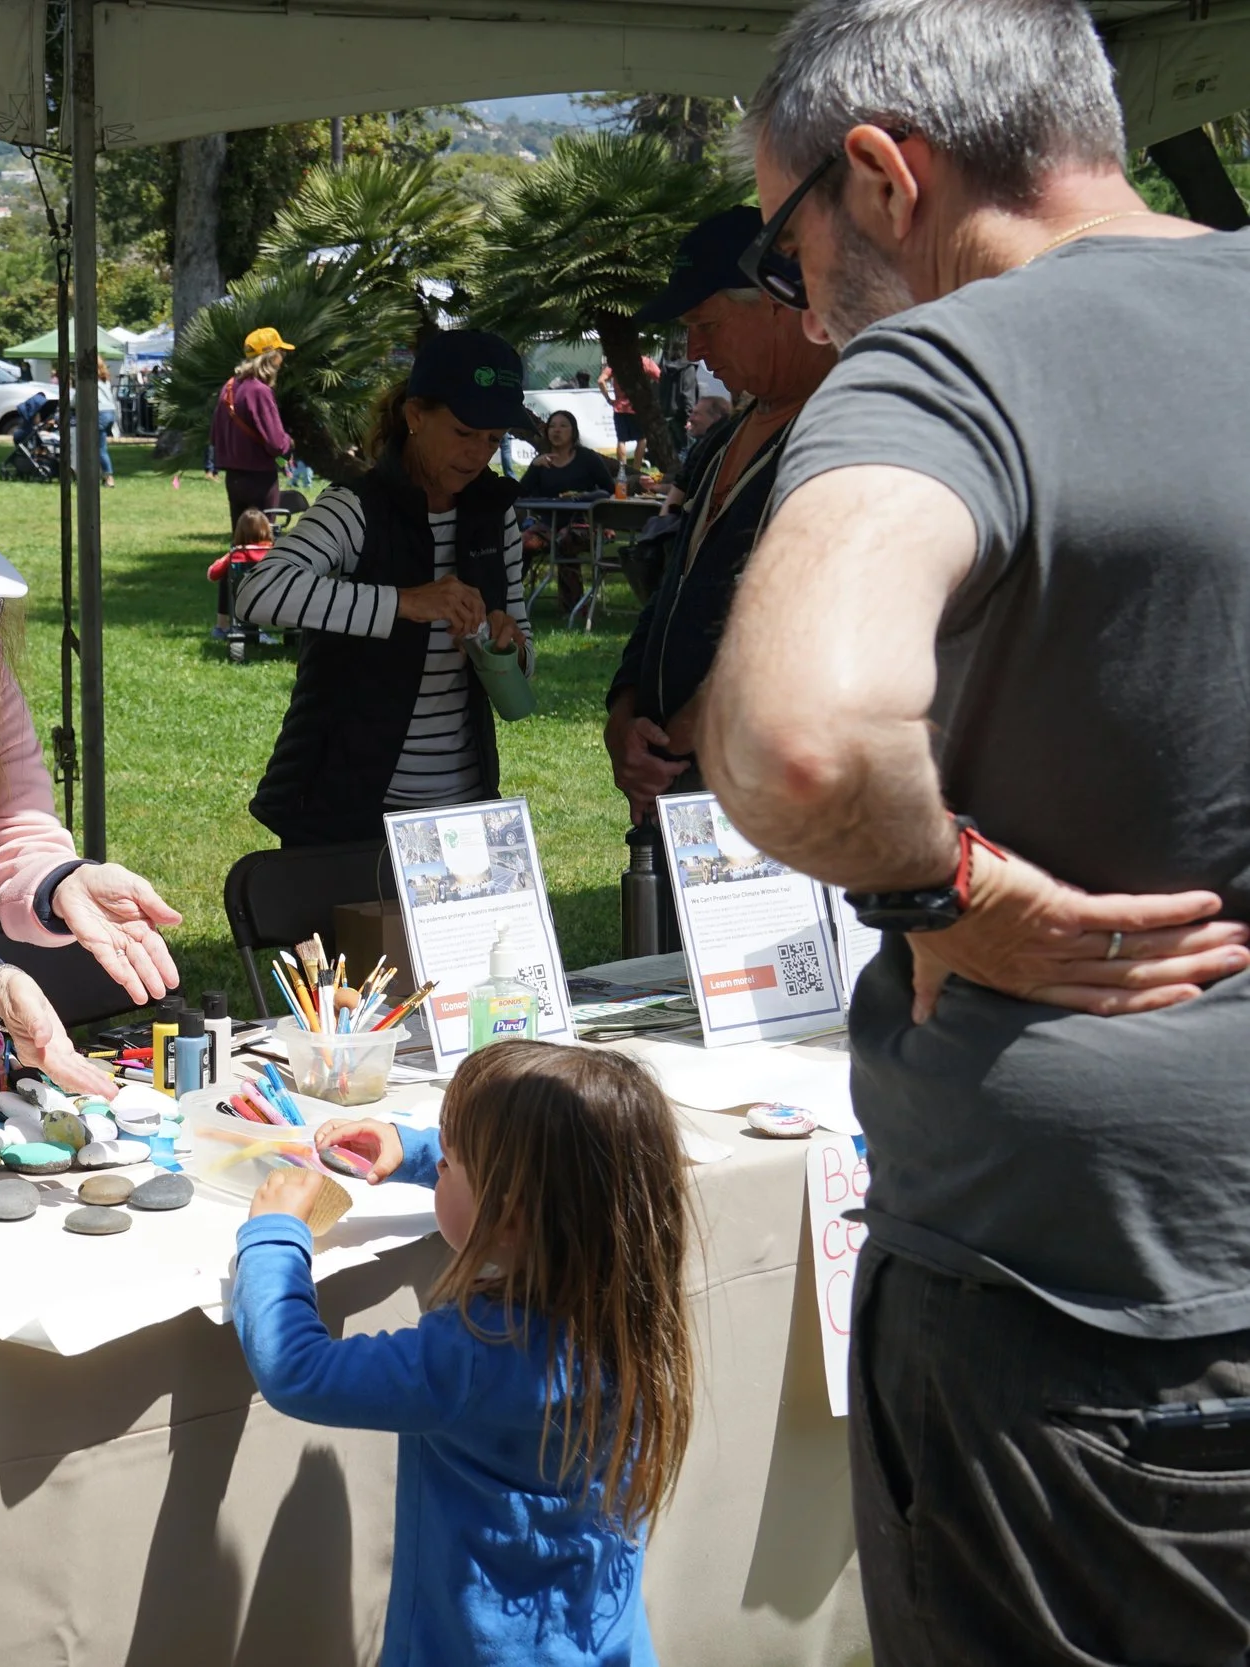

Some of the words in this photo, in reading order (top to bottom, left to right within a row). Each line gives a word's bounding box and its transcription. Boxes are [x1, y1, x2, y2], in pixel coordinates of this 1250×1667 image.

[710, 977, 733, 990] Learn
[733, 974, 756, 987] more!
[440, 1001, 469, 1013] ¡Conoc
[498, 998, 522, 1007] BONUS
[496, 1020, 525, 1032] Purell
